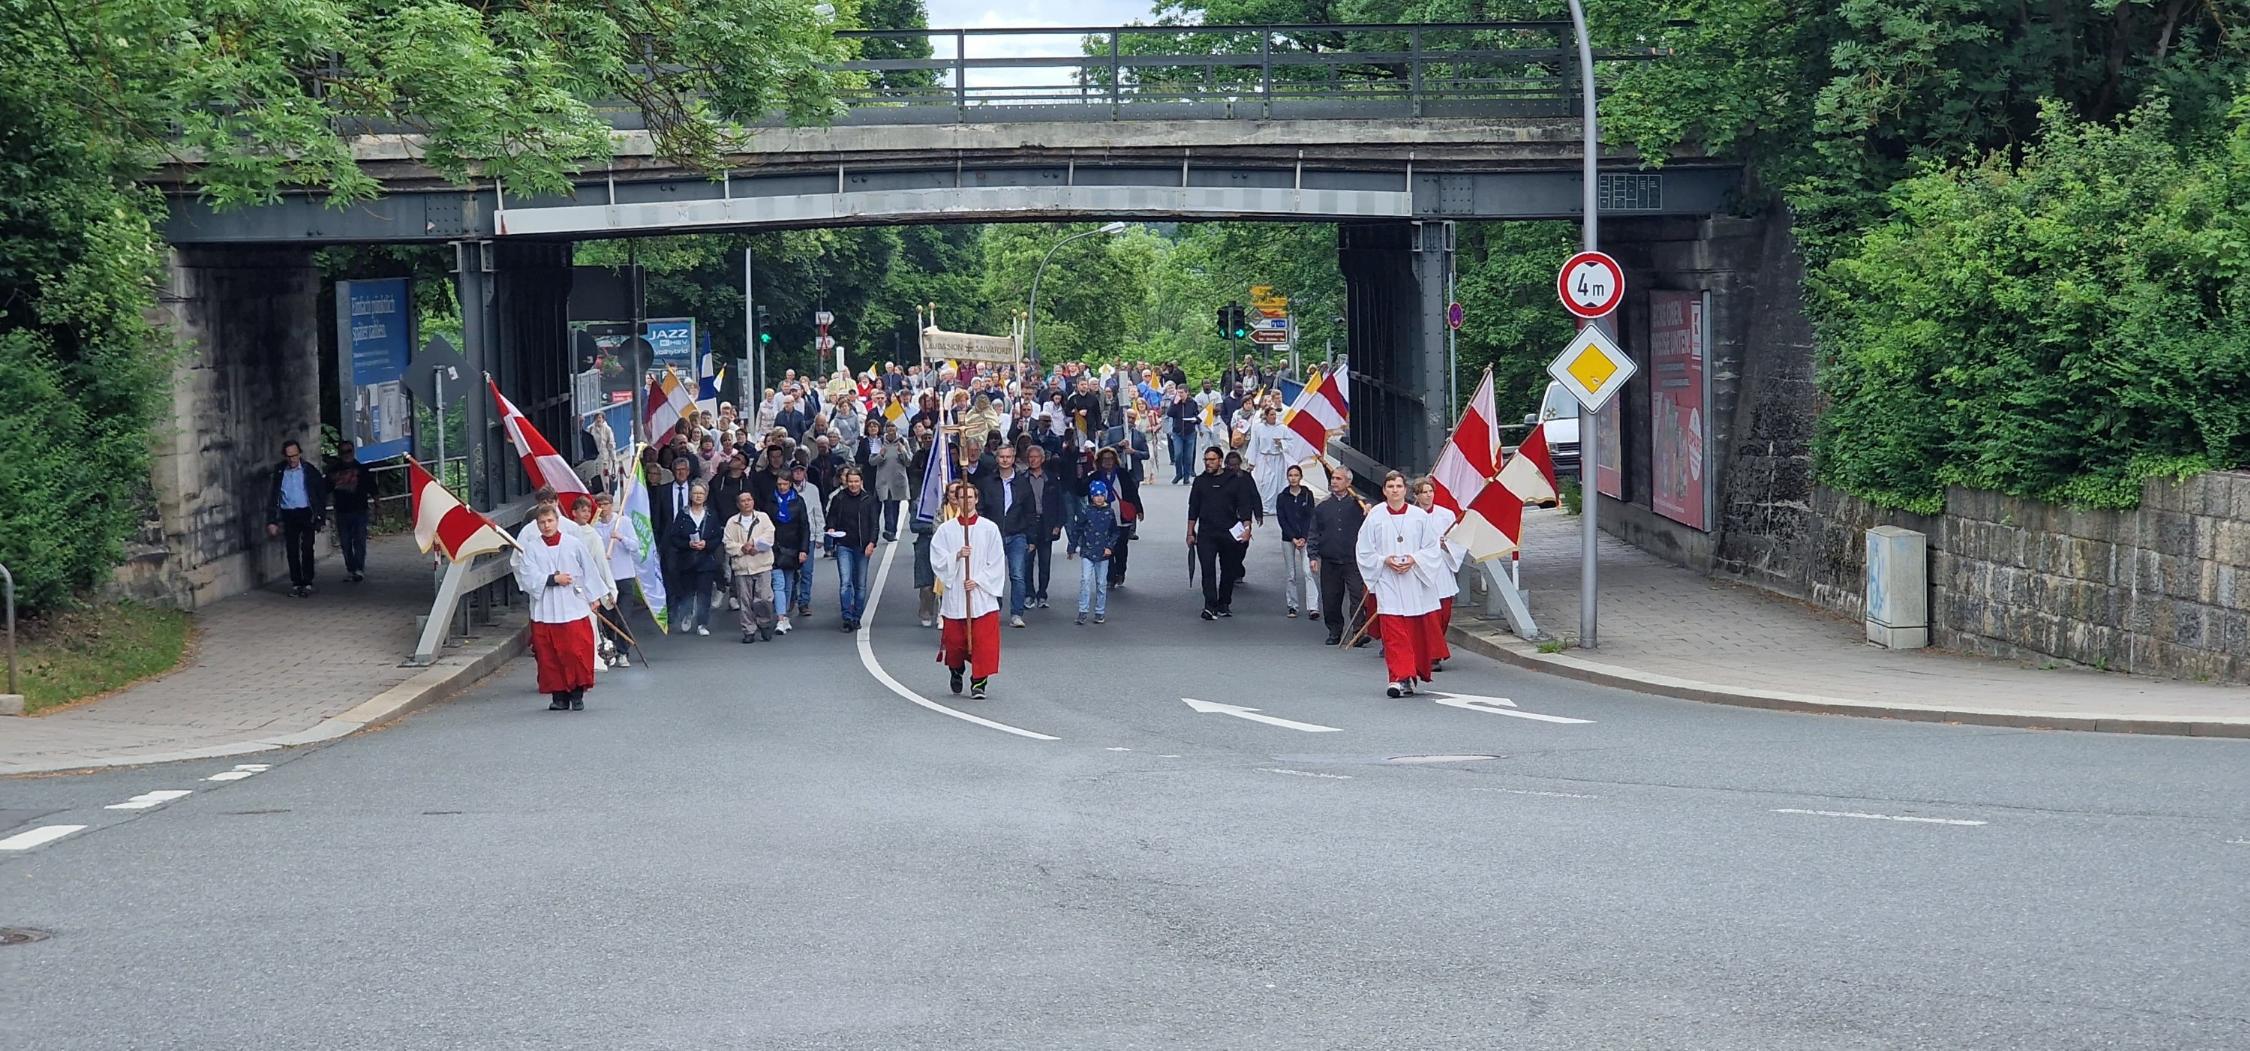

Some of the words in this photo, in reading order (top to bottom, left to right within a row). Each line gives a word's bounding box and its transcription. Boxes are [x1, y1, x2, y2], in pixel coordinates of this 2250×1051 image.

[1578, 273, 1588, 296] 4
[1593, 284, 1604, 296] m
[648, 329, 688, 340] JAZZ
